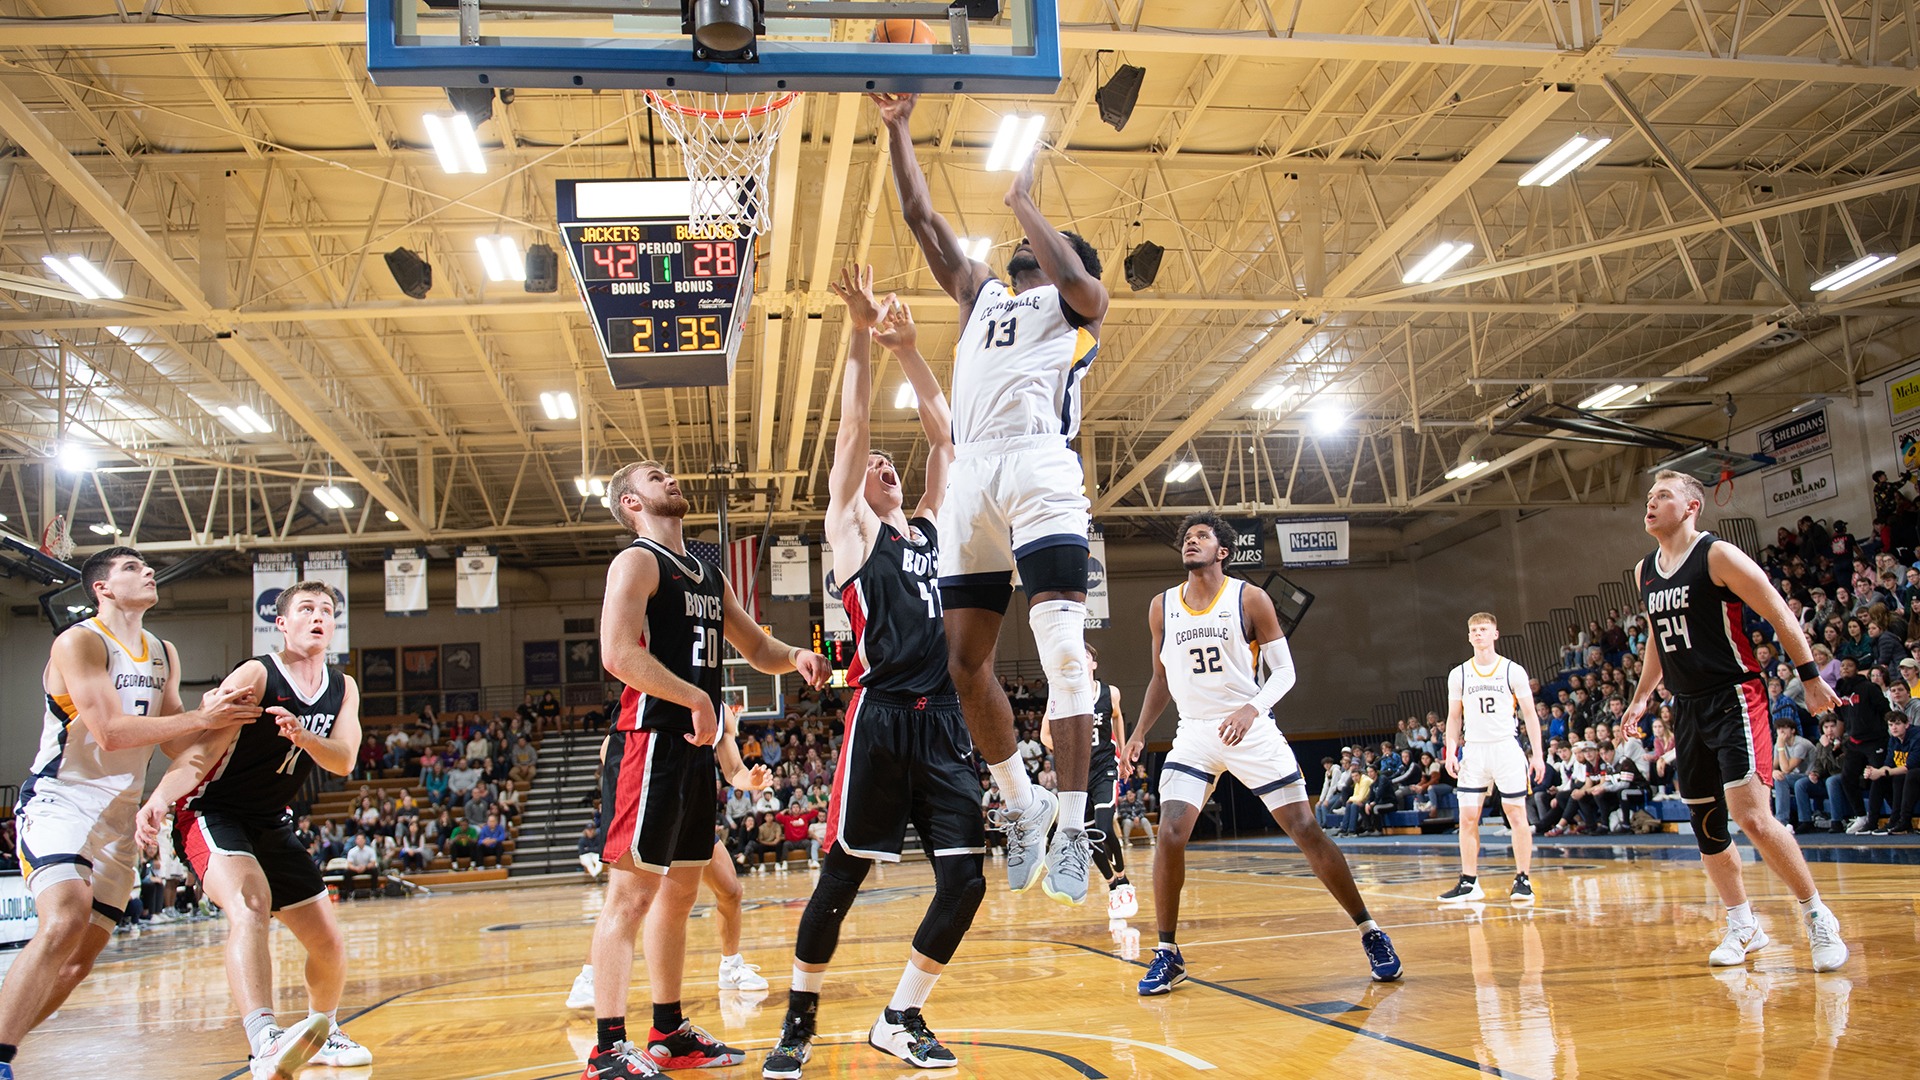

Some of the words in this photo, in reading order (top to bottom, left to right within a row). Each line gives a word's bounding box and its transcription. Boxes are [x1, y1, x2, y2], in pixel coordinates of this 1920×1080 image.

[580, 227, 640, 242] JACKETS
[638, 242, 682, 254] PERIOD
[593, 245, 636, 278] 42
[693, 242, 736, 276] 28
[662, 255, 671, 283] 1
[611, 282, 651, 295] BONUS
[674, 280, 713, 293] BONUS
[652, 300, 675, 309] POSS
[985, 317, 1016, 349] 13
[1774, 416, 1824, 442] SHERIDANS
[1233, 534, 1256, 546] KE
[1290, 531, 1336, 549] NCCAA
[258, 553, 293, 562] WOMEN'S
[308, 551, 343, 560] WOMEN'S
[1232, 549, 1262, 562] URS
[253, 562, 297, 571] BASKETBALL
[304, 560, 348, 569] BASKETBALL
[684, 591, 722, 621] BOYCE
[1648, 585, 1690, 615] BOYCE
[260, 604, 278, 616] NC
[1084, 619, 1102, 629] 022
[1176, 627, 1229, 645] CEDARVILLE
[1657, 615, 1692, 653] 24
[692, 625, 718, 668] 20
[1190, 647, 1223, 674] 32
[1467, 685, 1504, 695] CEDARVILLE
[1479, 697, 1496, 713] 12
[297, 713, 335, 738] OYCE
